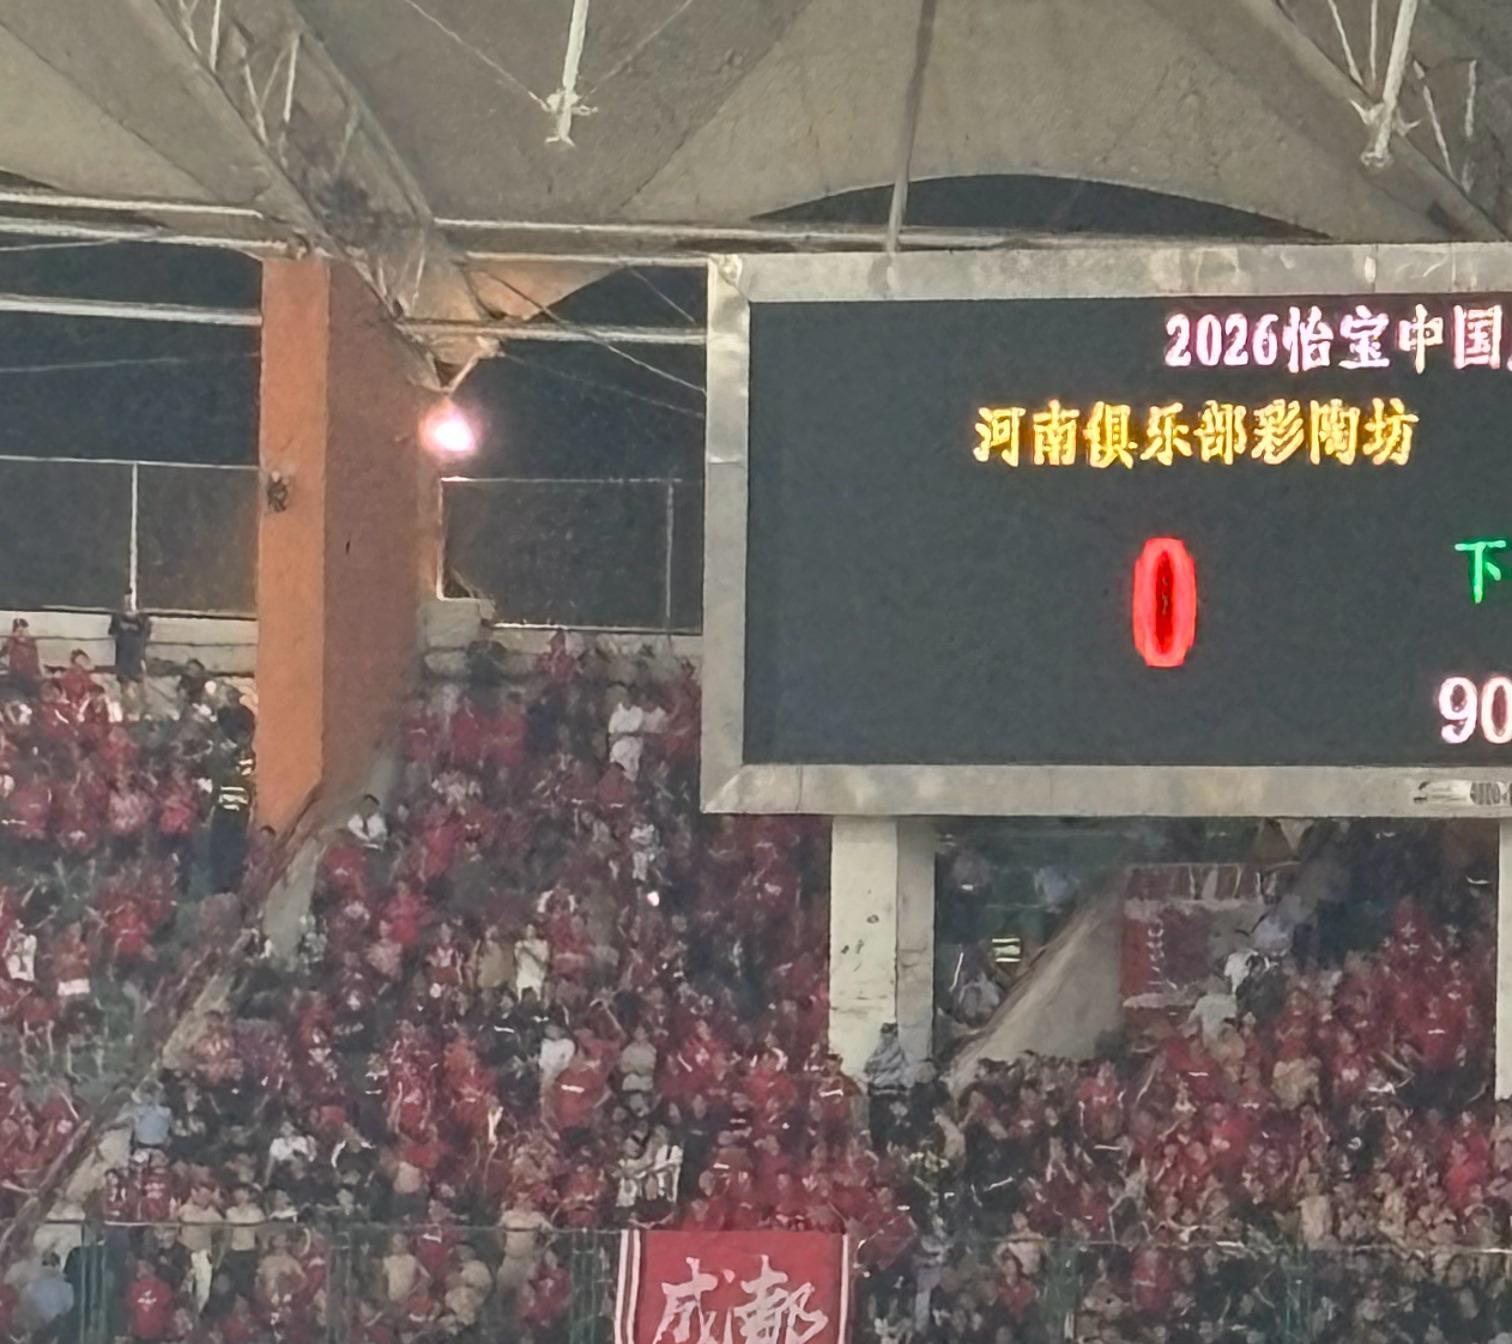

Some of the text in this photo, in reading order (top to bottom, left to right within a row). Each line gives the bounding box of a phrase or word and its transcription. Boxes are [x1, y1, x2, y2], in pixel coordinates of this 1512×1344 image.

[973, 398, 1420, 469] 河南俱乐部彩陶坊
[1132, 536, 1197, 668] 0
